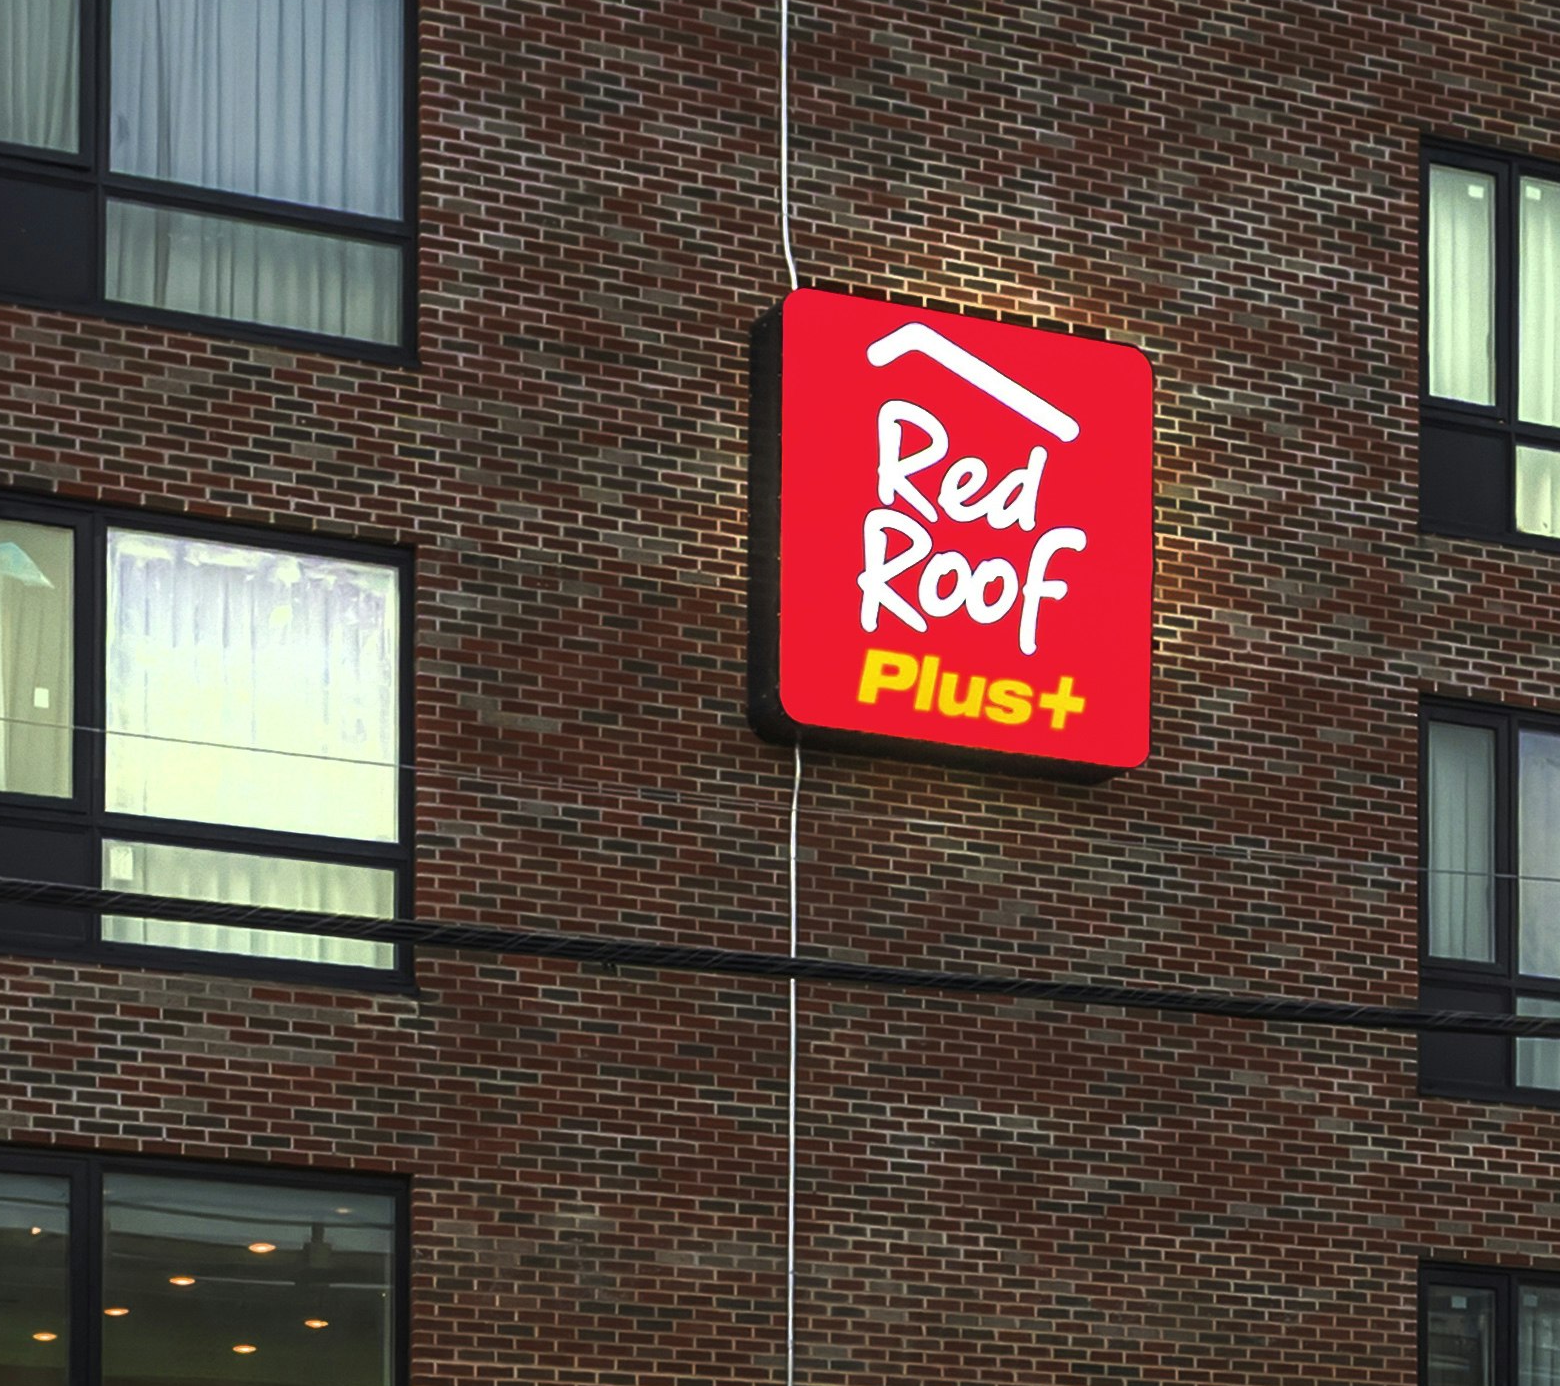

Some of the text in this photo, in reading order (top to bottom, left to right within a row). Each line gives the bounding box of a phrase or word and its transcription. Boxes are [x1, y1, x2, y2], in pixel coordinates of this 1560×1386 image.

[876, 398, 1048, 532] Red
[857, 508, 1087, 655] Roof
[856, 649, 1086, 730] Plus+
